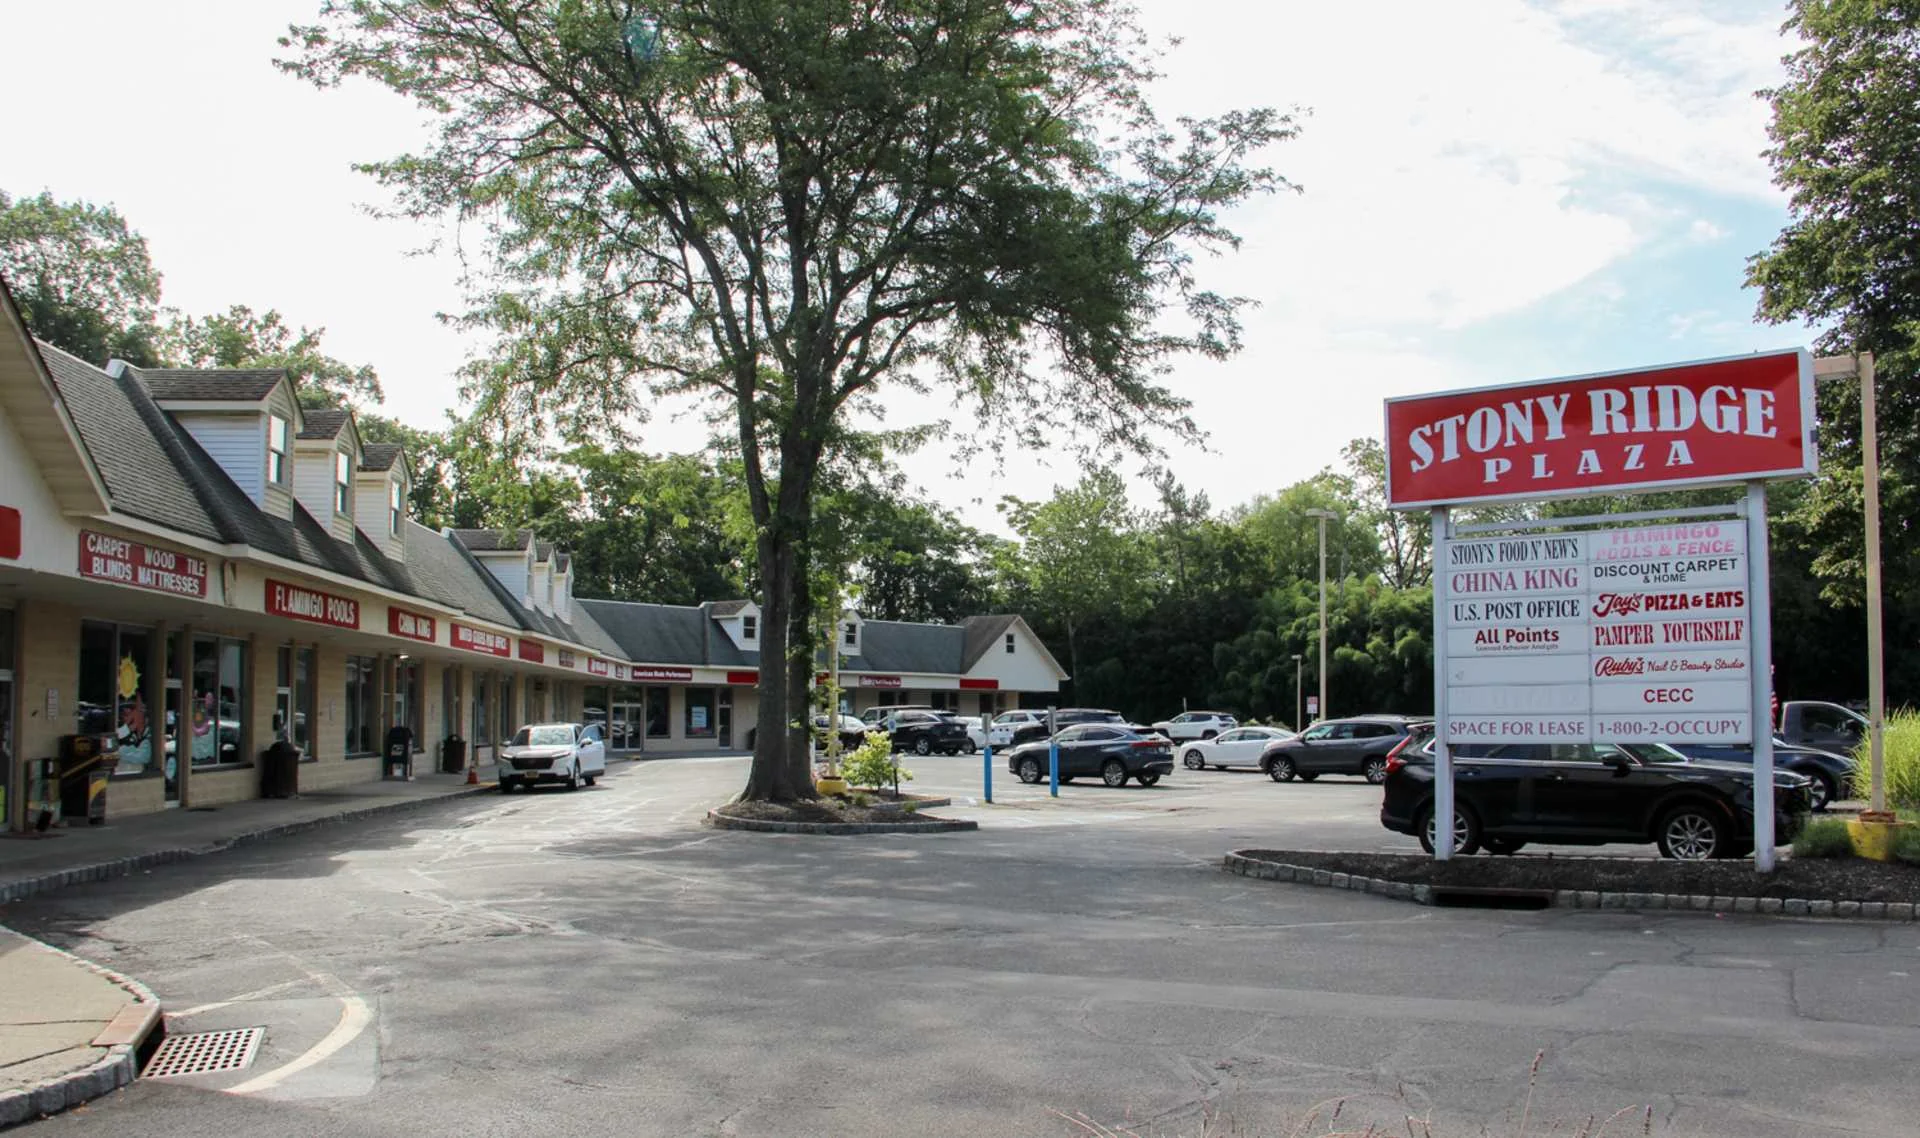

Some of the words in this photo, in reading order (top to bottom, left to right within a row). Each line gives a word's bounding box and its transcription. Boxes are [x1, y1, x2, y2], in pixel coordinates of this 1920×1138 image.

[1408, 393, 1570, 473] STONY
[1587, 384, 1777, 438] RIDGE
[1483, 440, 1694, 483] PLAZA
[1612, 524, 1720, 544] FLAMINGO
[87, 534, 131, 560] CARPET
[144, 546, 175, 569] WOOD
[187, 558, 205, 576] TILE
[1451, 543, 1495, 565] STONY'S
[1499, 541, 1528, 562] FOOD
[1544, 538, 1578, 560] NEW'S
[1596, 545, 1653, 560] POOLS
[1658, 544, 1672, 556] &
[1677, 539, 1735, 555] FENCE
[92, 556, 132, 581] BLINDS
[138, 566, 199, 594] MATTRESSES
[1594, 562, 1670, 578] DISCOUNT
[1675, 558, 1738, 573] CARPET
[1643, 575, 1650, 583] &
[1654, 573, 1686, 582] HOME
[1452, 571, 1518, 593] CHINA
[1524, 568, 1578, 590] KING
[275, 585, 324, 618] FLAMINGO
[327, 598, 355, 624] POOLS
[1454, 603, 1481, 621] U.S.
[1485, 601, 1523, 620] POST
[1527, 599, 1580, 619] OFFICE
[1592, 592, 1644, 617] Jay's
[1645, 593, 1689, 611] PIZZA
[1691, 595, 1703, 607] &
[1705, 591, 1744, 608] EATS
[1475, 629, 1500, 644] All
[1505, 627, 1559, 643] Points
[1594, 624, 1654, 646] PAMPER
[1662, 620, 1743, 643] YOURSELF
[1594, 656, 1644, 676] Ruby's
[1647, 660, 1667, 672] Nail
[1670, 660, 1679, 671] &
[1680, 659, 1712, 672] Beauty
[1714, 658, 1745, 670] Studio
[1644, 688, 1694, 703] CECC
[1449, 721, 1496, 735] SPACE
[1502, 721, 1533, 735] FOR
[1539, 721, 1585, 735] LEASE
[1598, 720, 1742, 735] 1-800-2-OCCUPY
